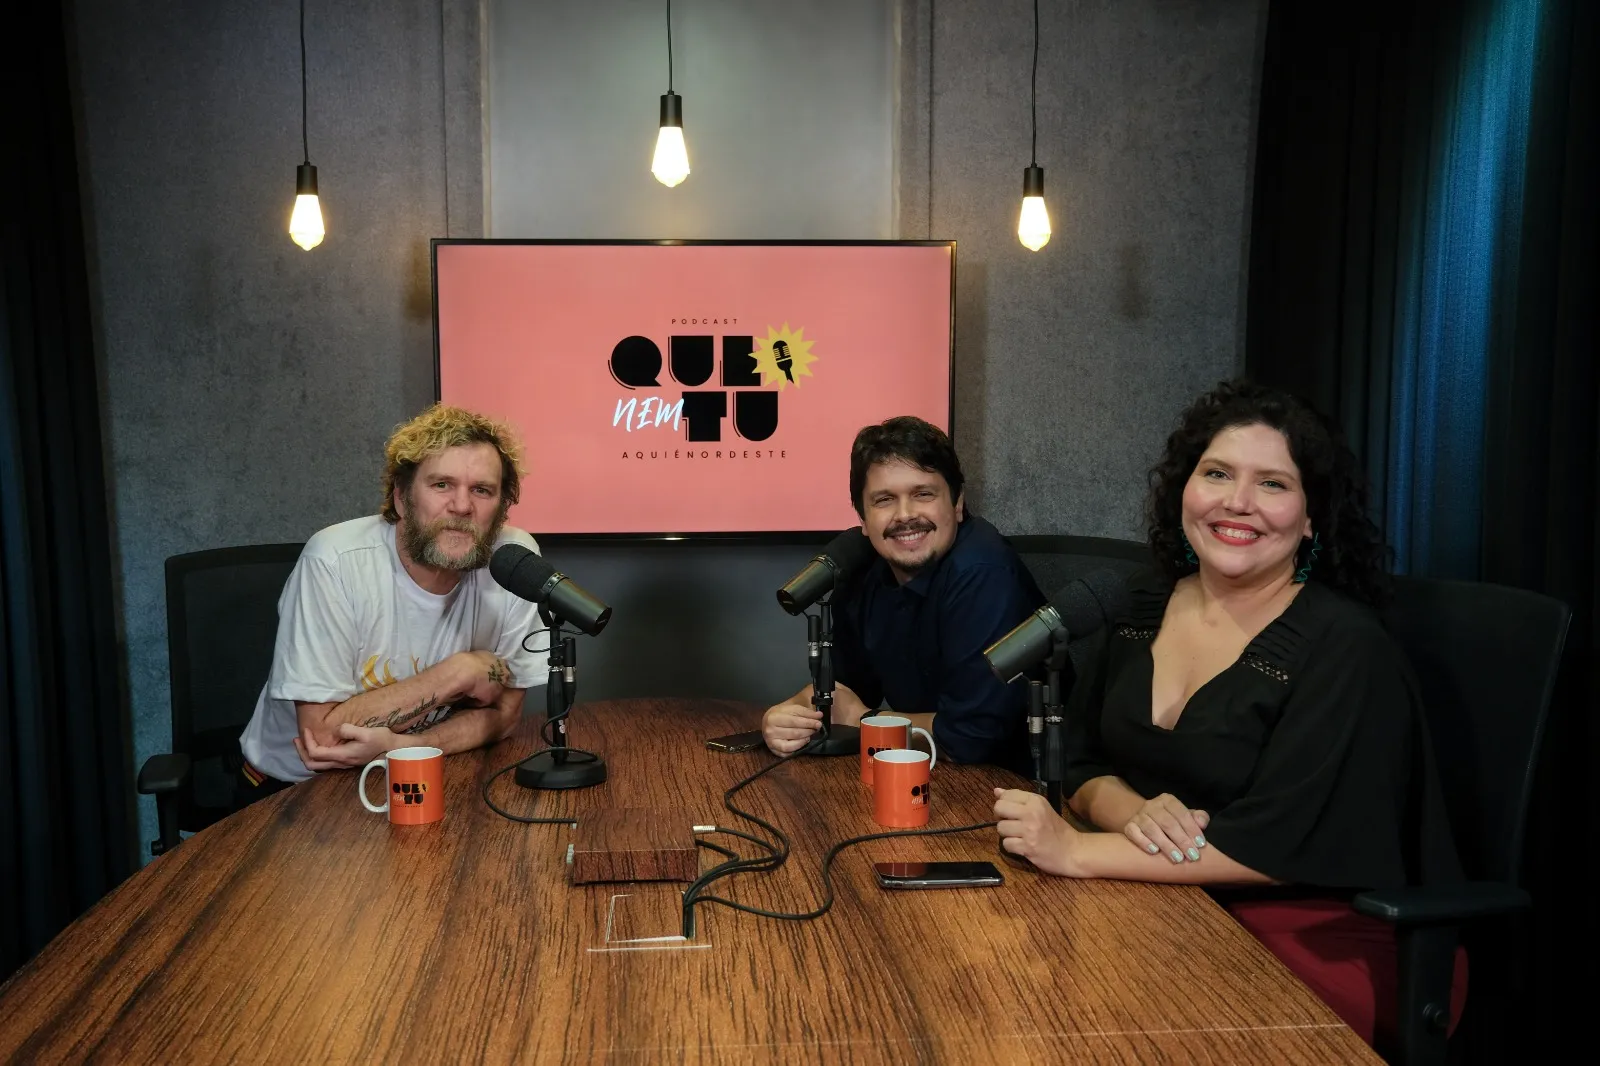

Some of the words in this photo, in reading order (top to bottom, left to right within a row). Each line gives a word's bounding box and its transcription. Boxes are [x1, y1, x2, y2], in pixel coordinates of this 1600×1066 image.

[608, 335, 762, 390] QUE
[612, 396, 685, 432] NEM
[682, 391, 779, 442] TU
